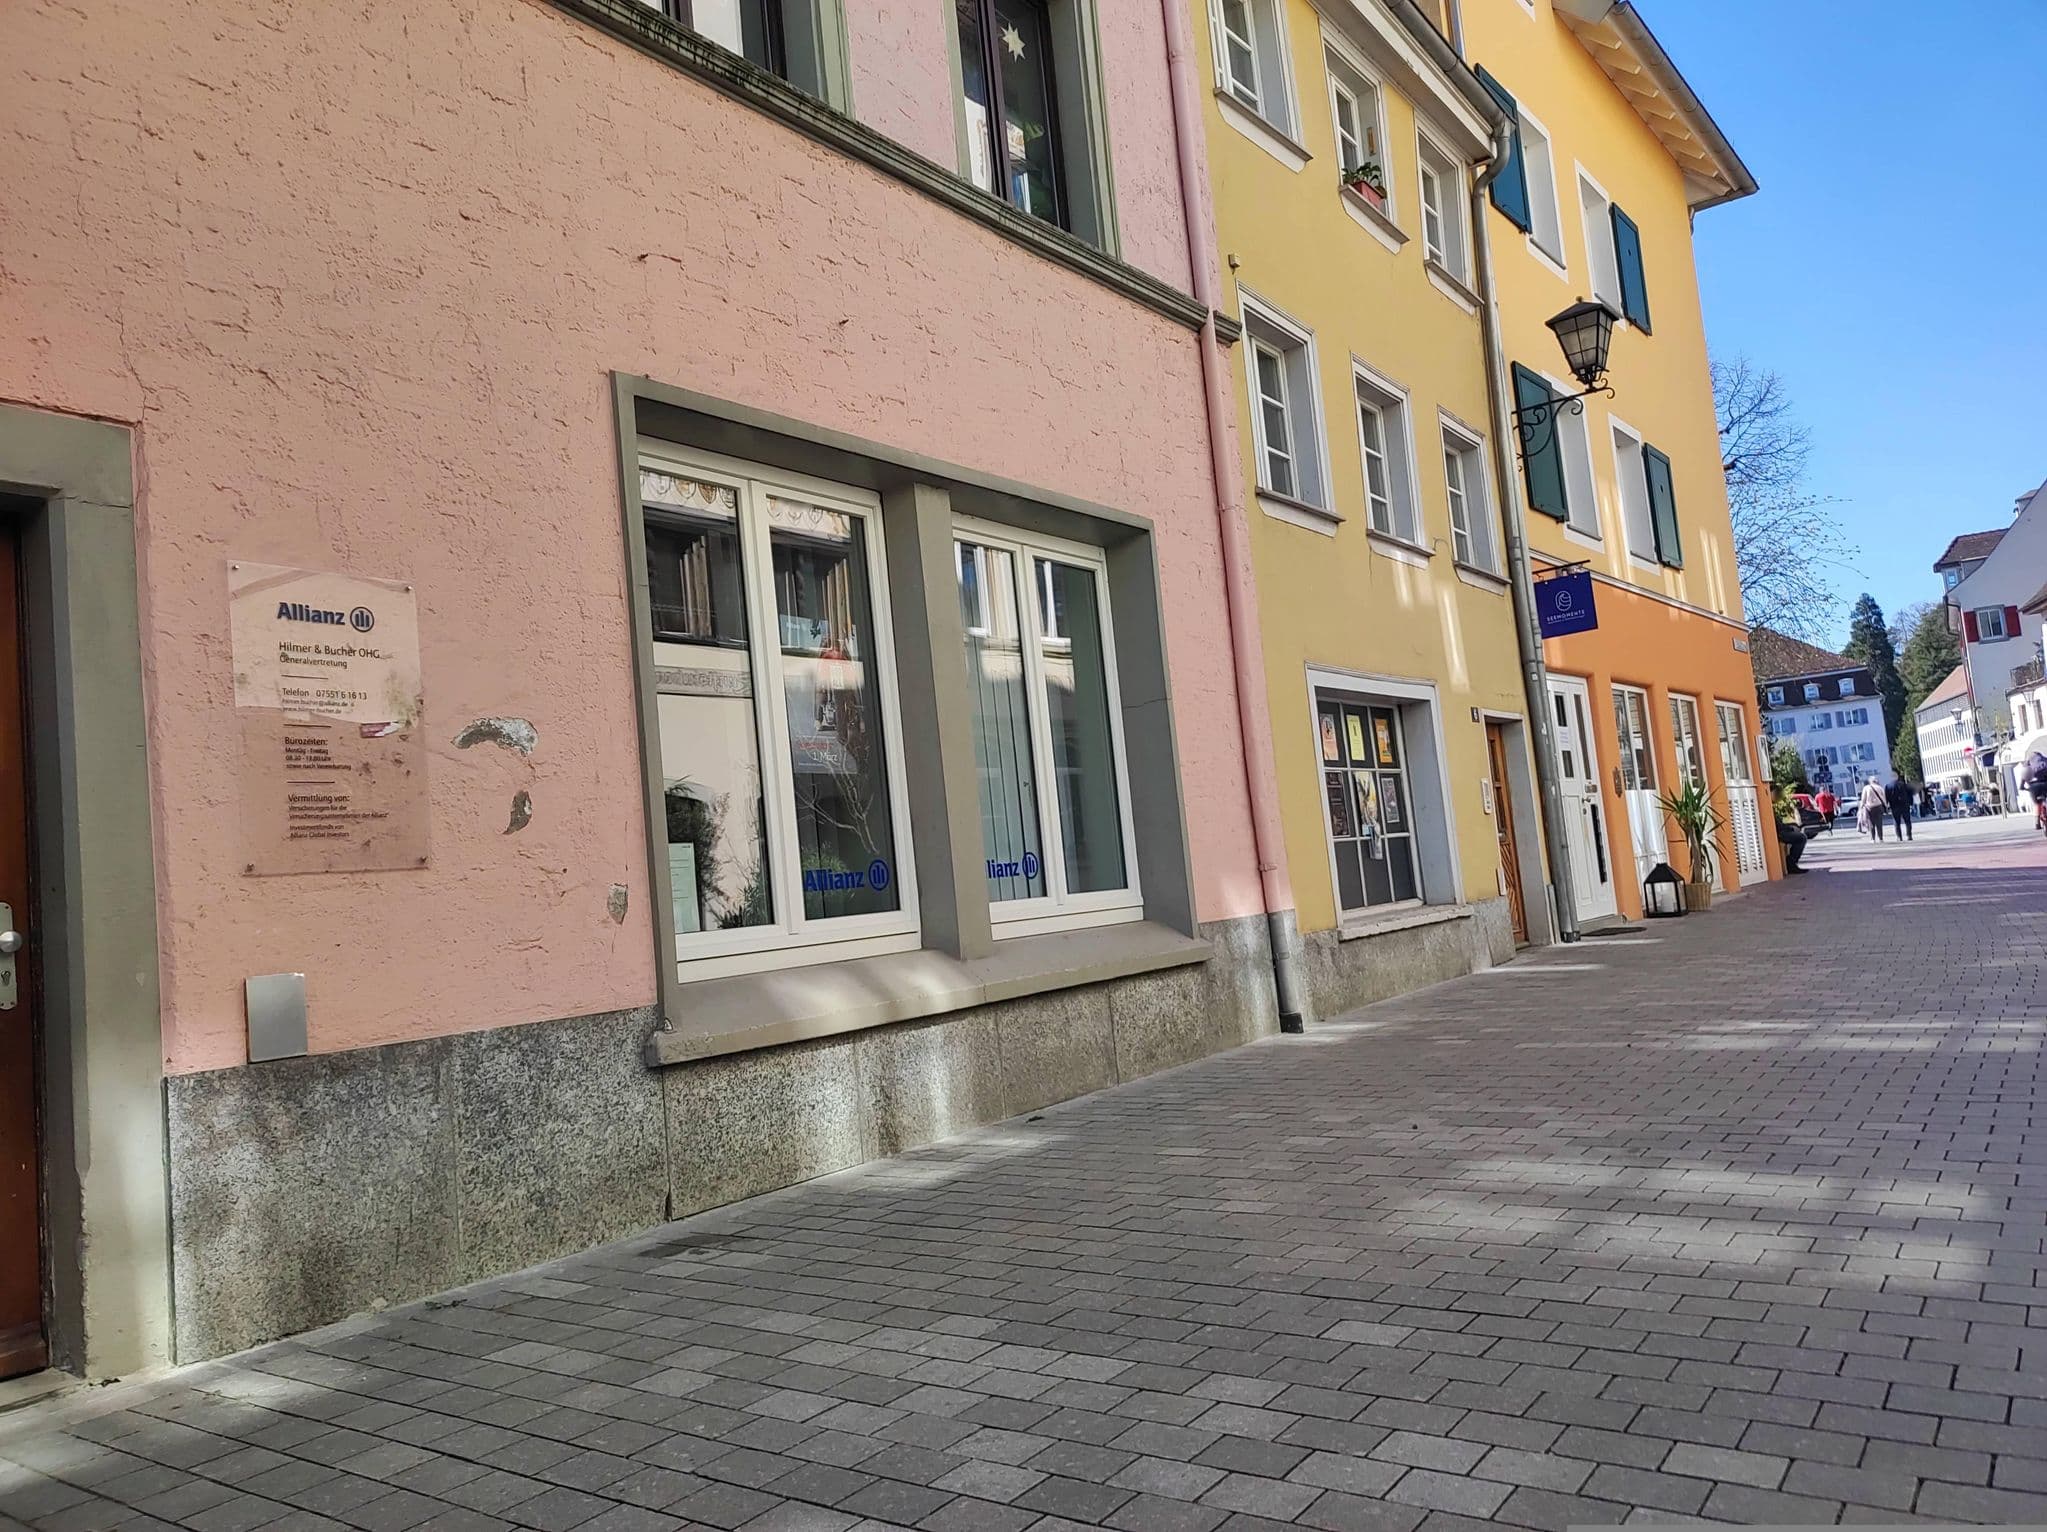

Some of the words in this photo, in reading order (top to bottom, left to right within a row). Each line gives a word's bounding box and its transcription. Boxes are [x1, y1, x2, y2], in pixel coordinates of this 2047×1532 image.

[277, 602, 345, 626] Allianz
[279, 641, 312, 653] Hilmer
[314, 645, 322, 654] &
[325, 645, 357, 657] Bucher
[359, 648, 380, 659] OHG
[280, 655, 348, 669] Generalvertretung
[282, 688, 309, 697] Telefon
[316, 690, 339, 699] 07551
[285, 736, 328, 746] Bürozeiten:
[288, 794, 332, 804] Vermittlung
[987, 860, 1019, 879] lianz
[805, 869, 864, 892] Allianz
